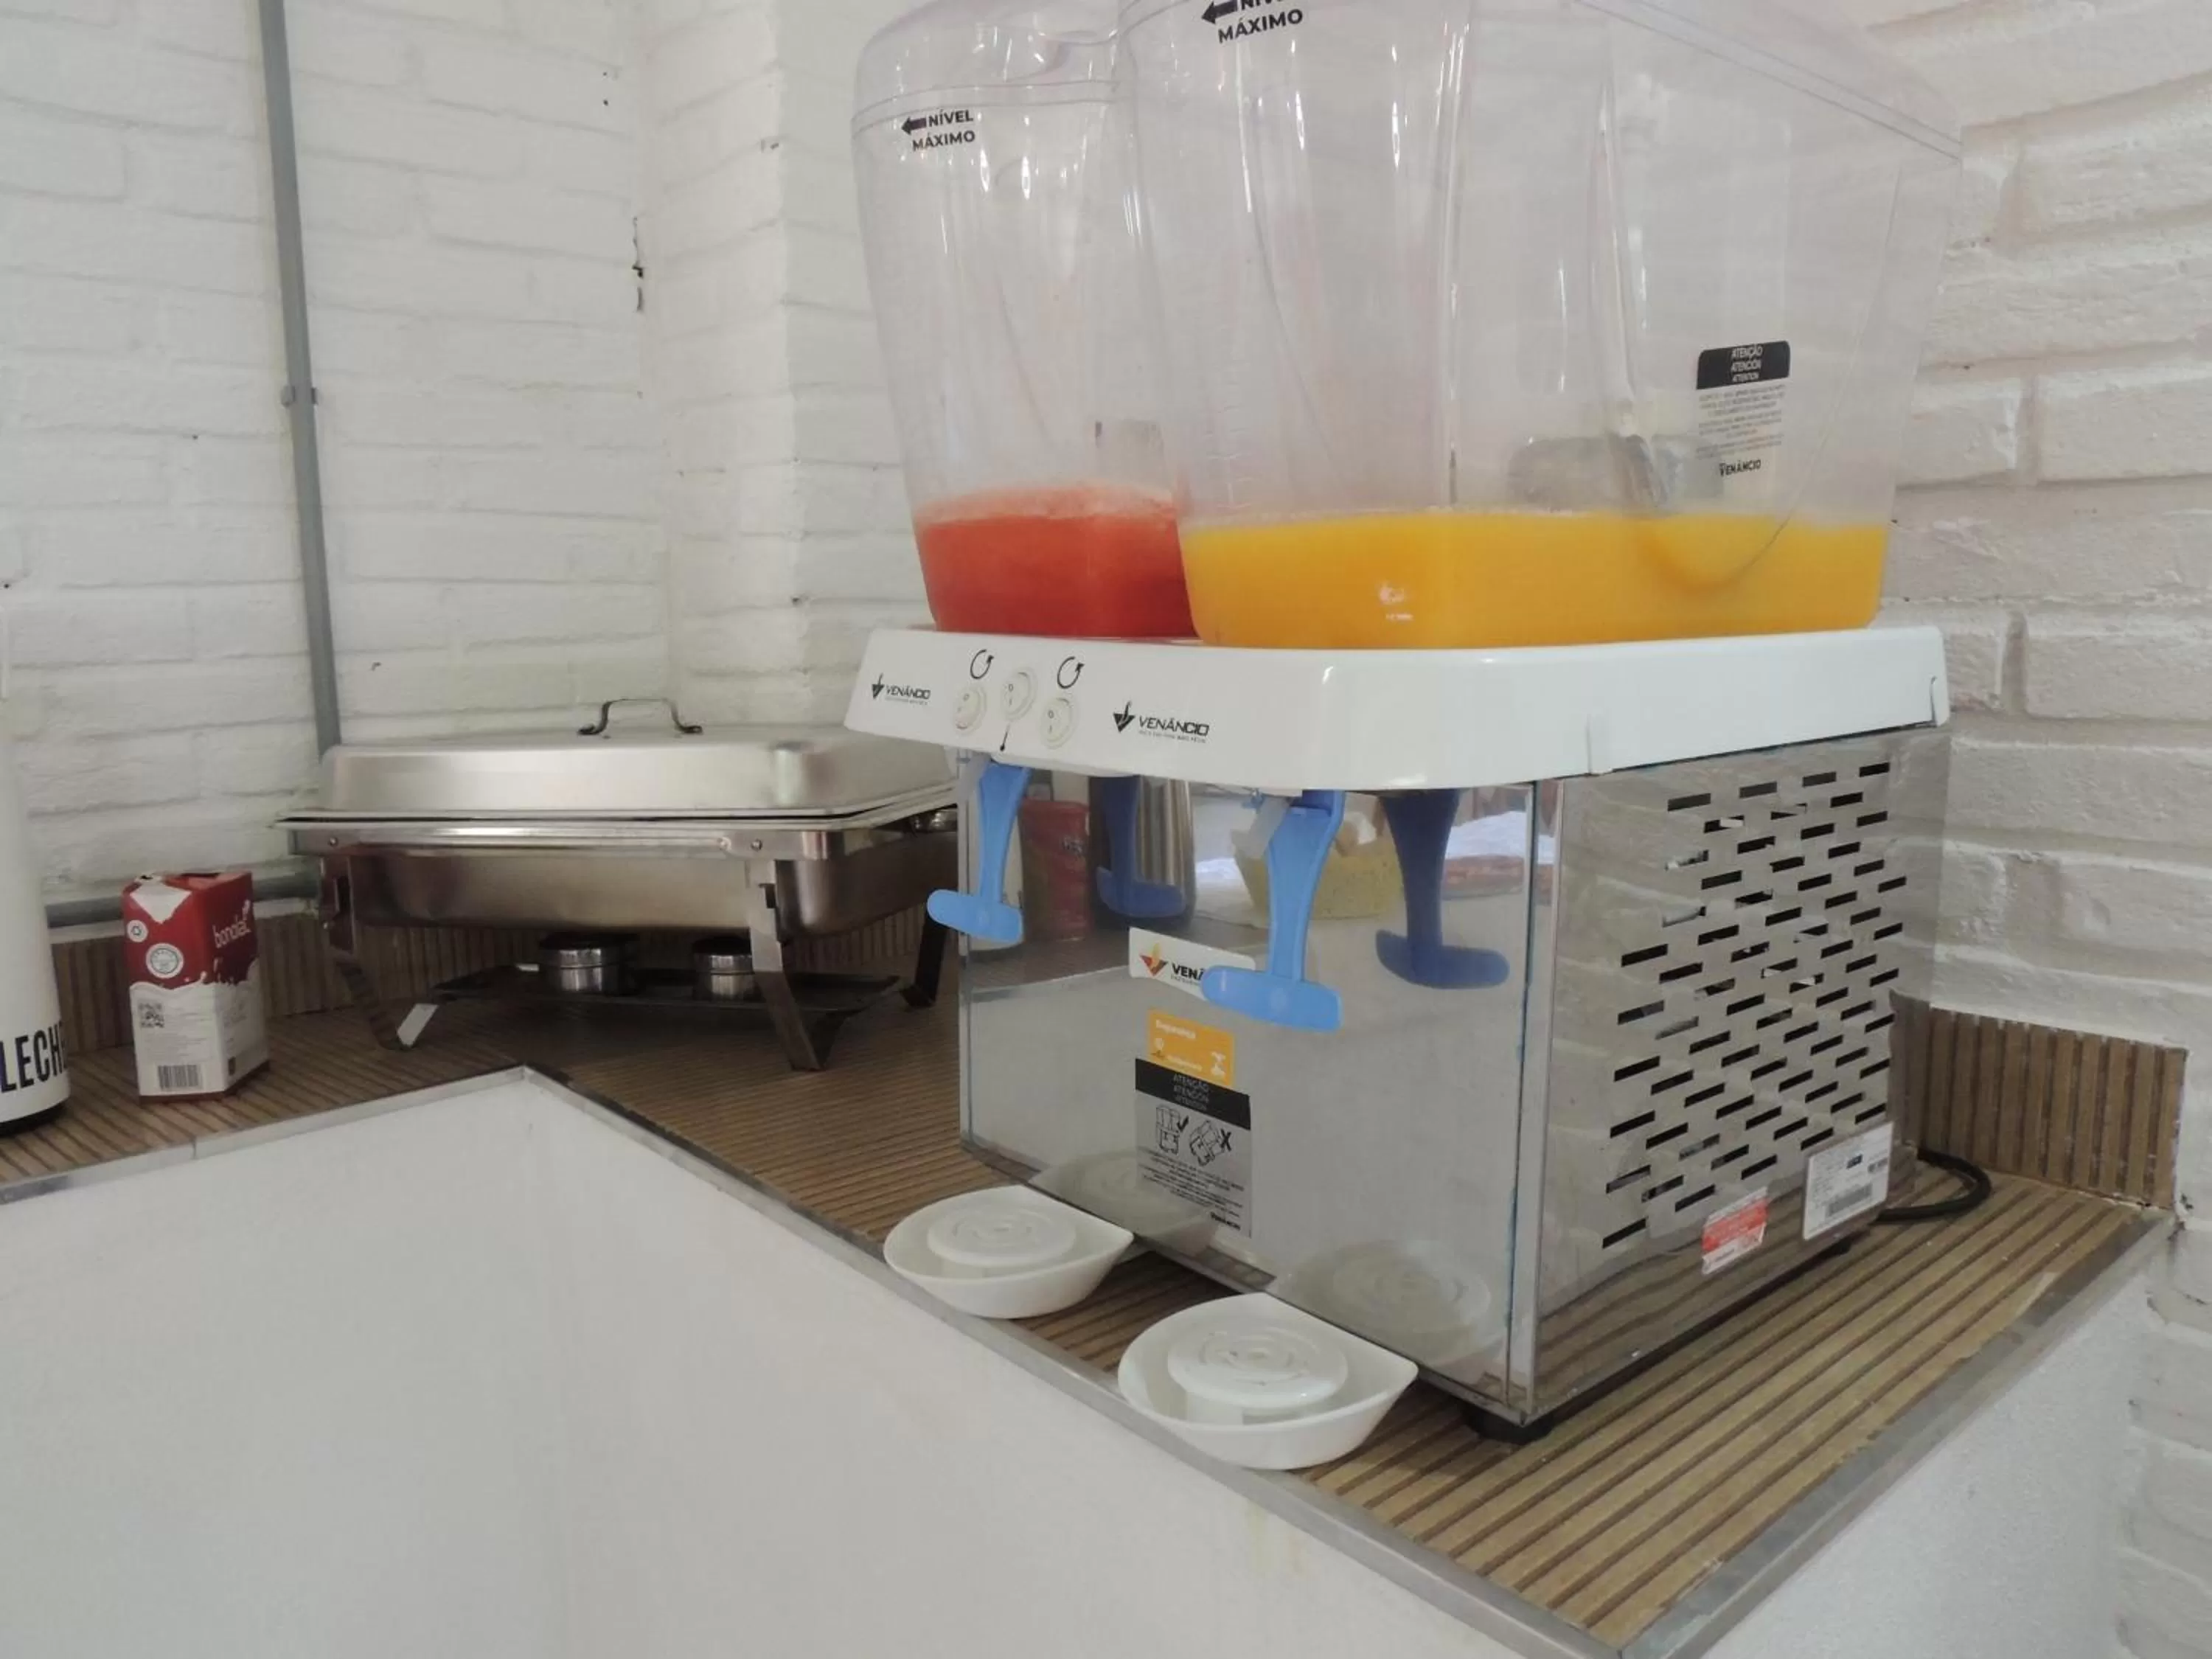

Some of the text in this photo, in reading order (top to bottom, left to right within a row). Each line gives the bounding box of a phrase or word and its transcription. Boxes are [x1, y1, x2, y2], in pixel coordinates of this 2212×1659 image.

[1217, 9, 1304, 44] MÁXIMO
[928, 109, 974, 127] NÍVEL
[912, 131, 975, 151] MÁXIMO
[1139, 715, 1209, 737] VENÂNCIO
[0, 1023, 67, 1093] LECH
